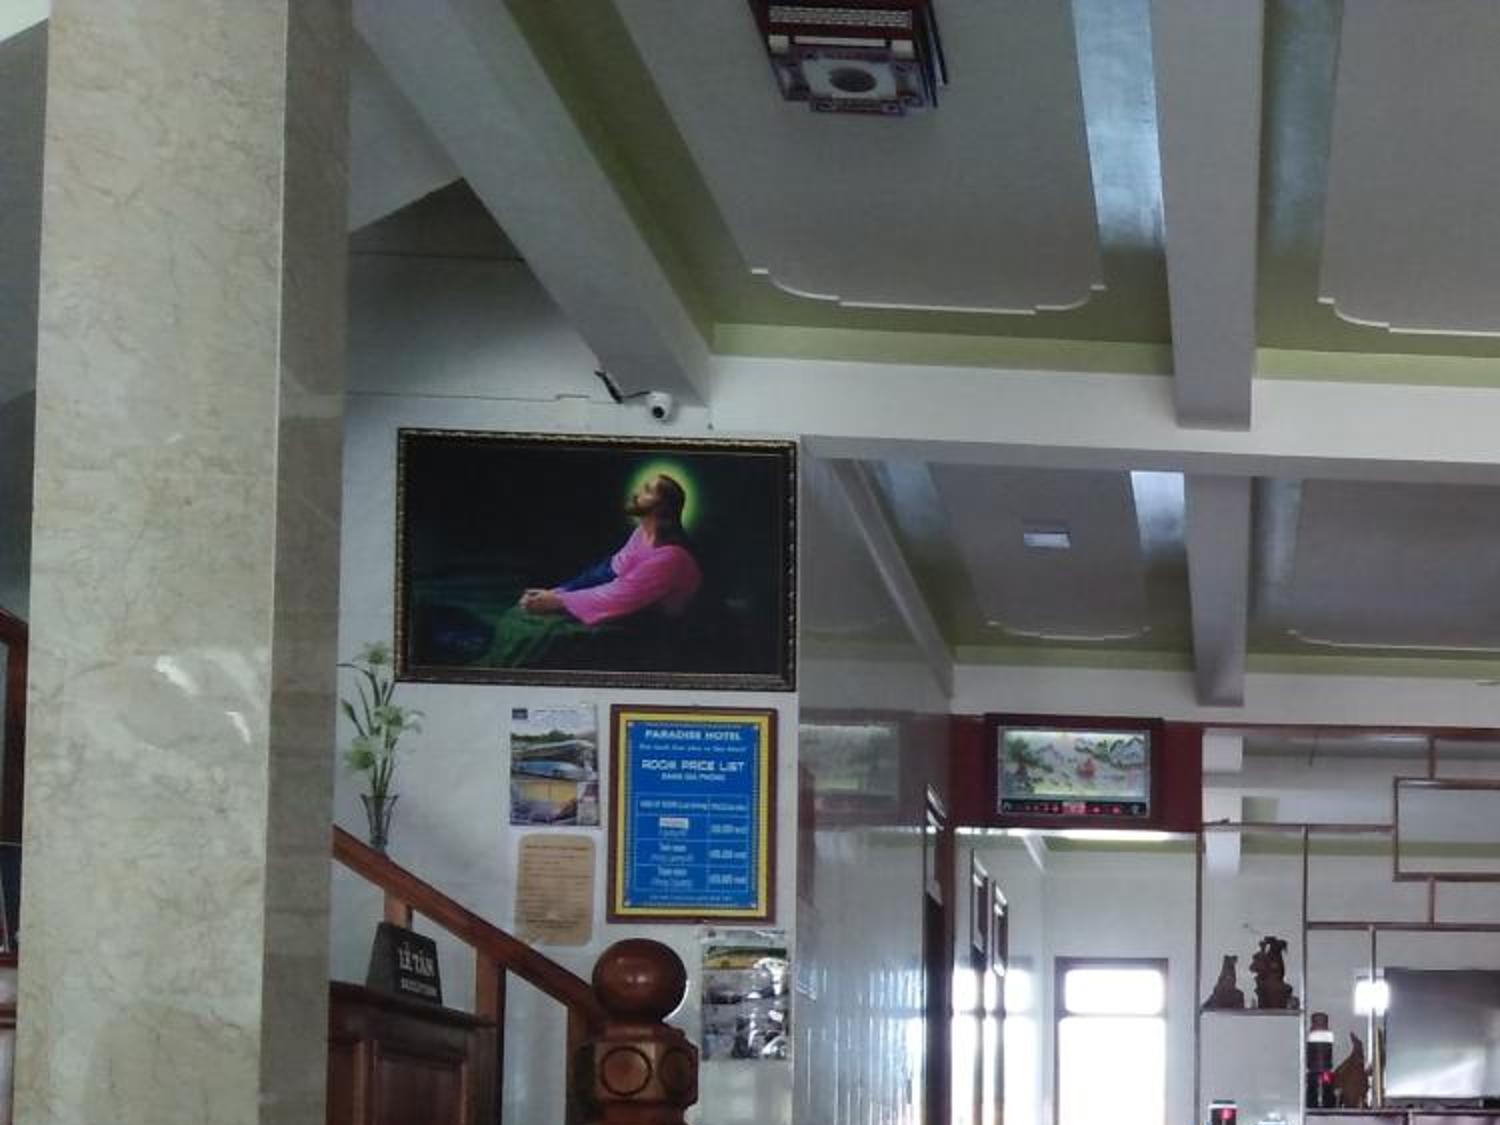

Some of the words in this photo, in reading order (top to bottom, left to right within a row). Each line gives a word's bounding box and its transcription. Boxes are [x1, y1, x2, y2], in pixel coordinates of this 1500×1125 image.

[644, 728, 701, 741] PARADISE
[704, 730, 742, 742] HOTEL
[641, 759, 677, 770] ROOM
[681, 759, 715, 771] PRICE
[718, 760, 745, 773] LIST
